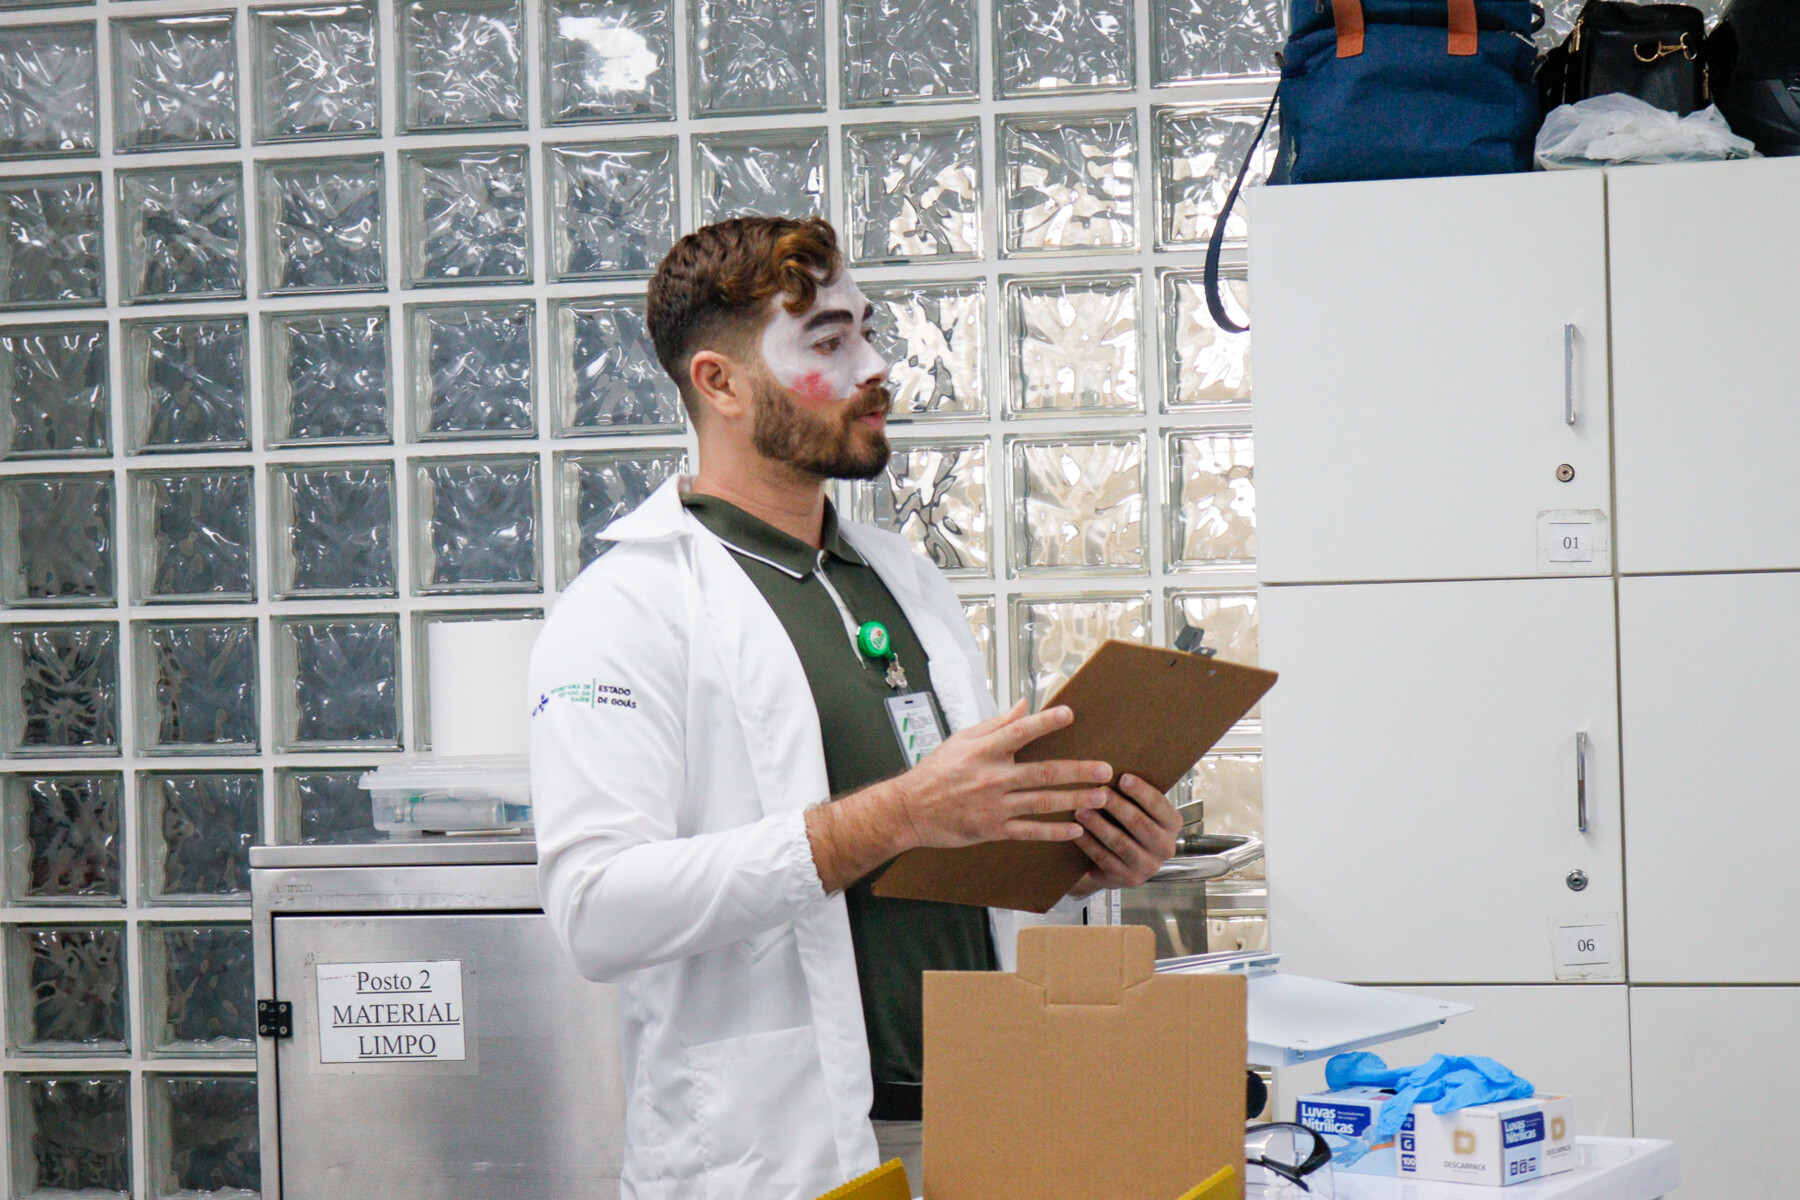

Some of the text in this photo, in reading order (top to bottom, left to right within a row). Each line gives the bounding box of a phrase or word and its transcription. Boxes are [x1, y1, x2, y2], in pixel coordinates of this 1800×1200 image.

[1563, 536, 1579, 549] 01
[599, 685, 631, 696] ESTADO
[597, 696, 608, 704] DE
[1577, 938, 1595, 952] 06
[357, 969, 431, 991] Posto 2
[332, 1003, 461, 1025] MATERIAL
[358, 1034, 437, 1055] LIMPO
[1301, 1103, 1336, 1119] Luvas
[1301, 1116, 1354, 1135] Nitrílicas
[1504, 1119, 1526, 1133] Luvas
[1404, 1139, 1412, 1150] G
[1443, 1160, 1487, 1171] DESCARPACK
